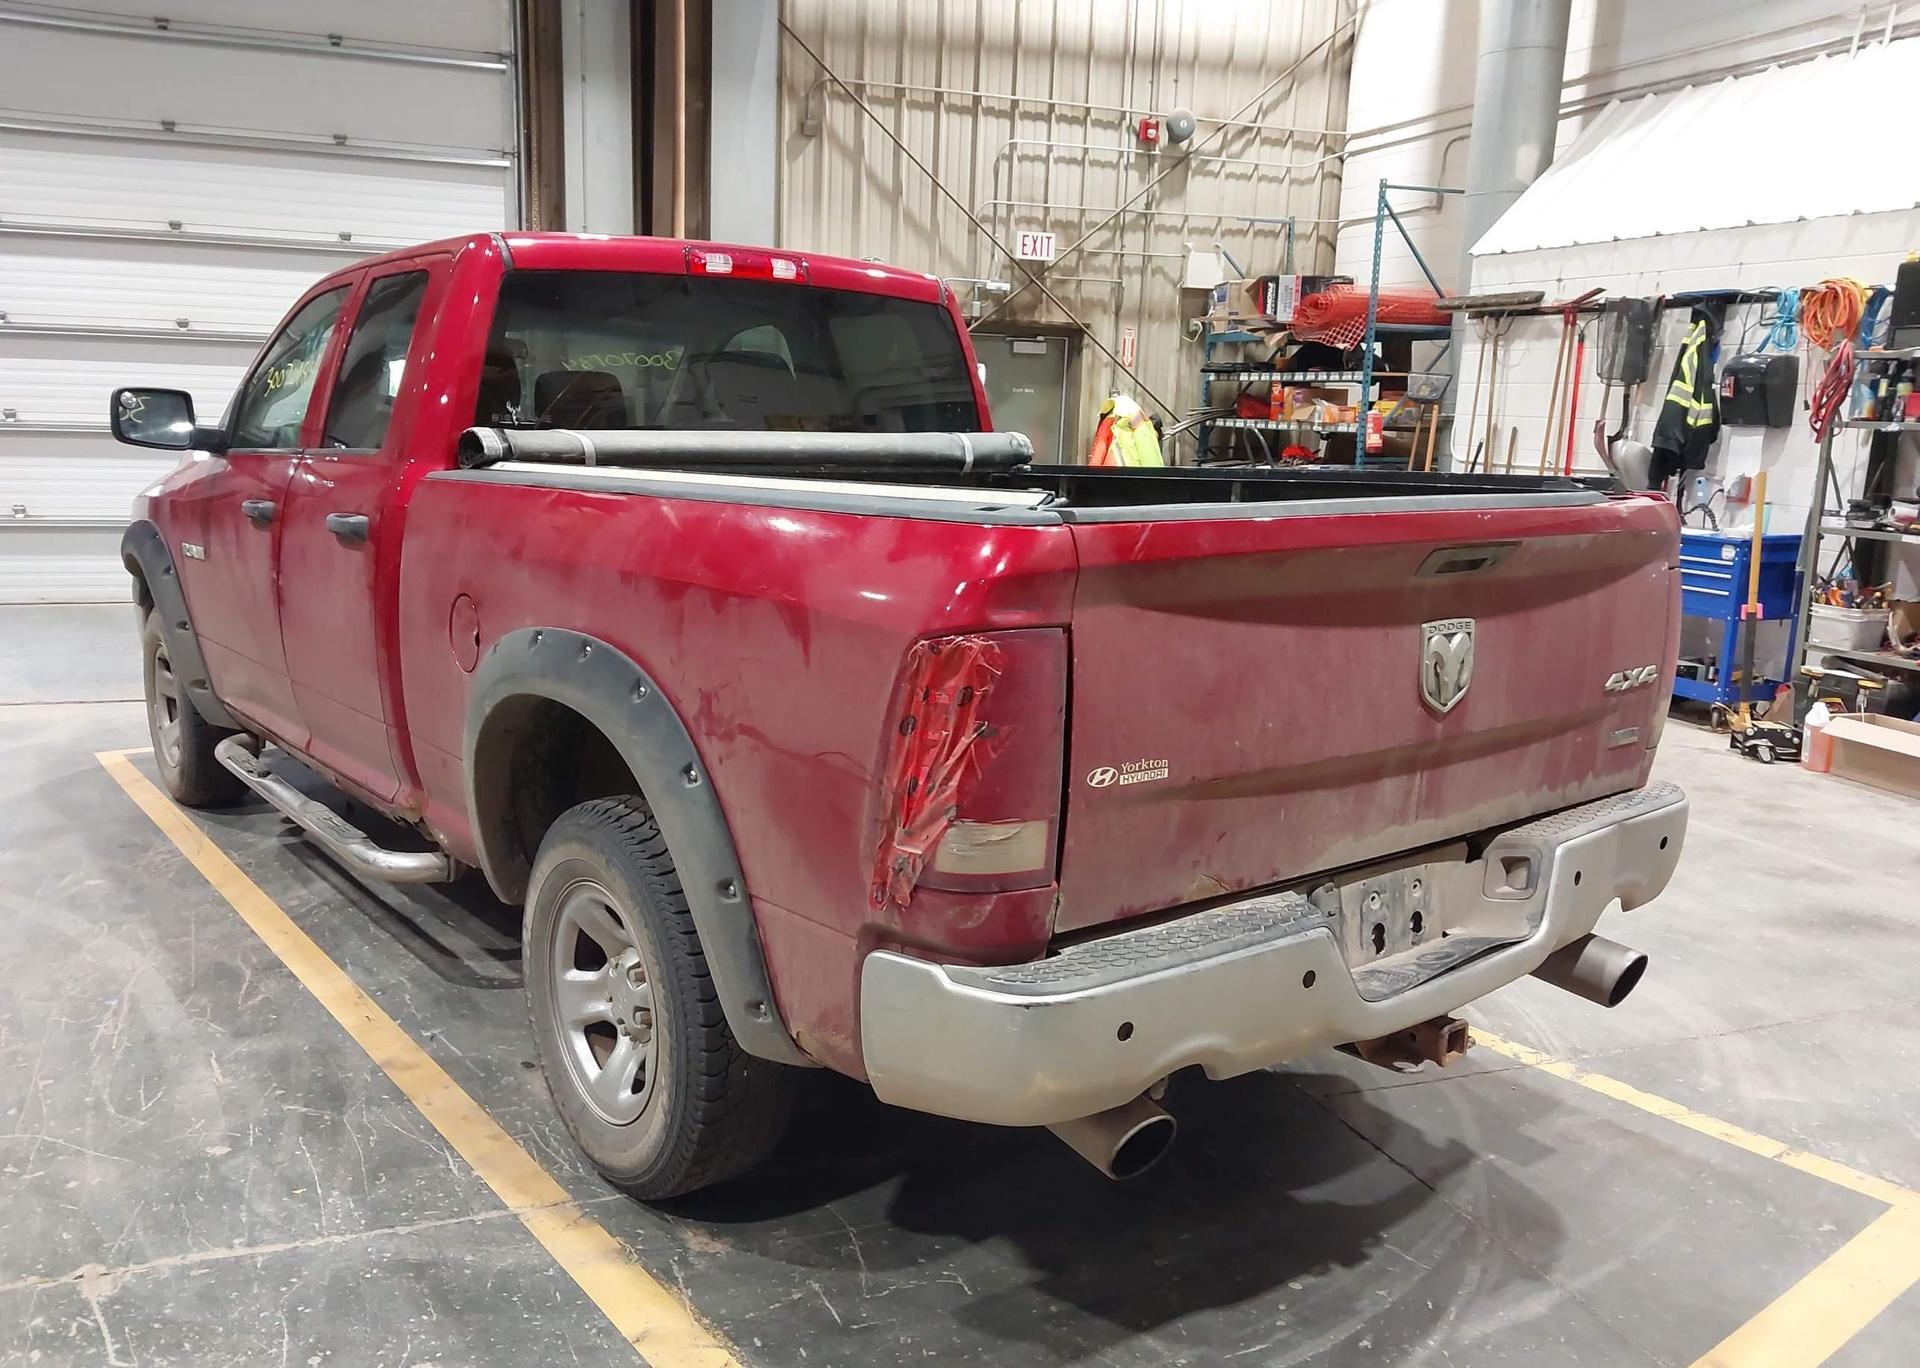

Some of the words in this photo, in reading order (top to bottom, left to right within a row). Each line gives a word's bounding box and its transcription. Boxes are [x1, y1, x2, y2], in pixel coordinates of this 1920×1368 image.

[1022, 234, 1052, 257] EXIT
[1428, 621, 1472, 634] DODGE
[1121, 758, 1168, 774] Yorkton
[1122, 769, 1166, 783] HYUNDAI
